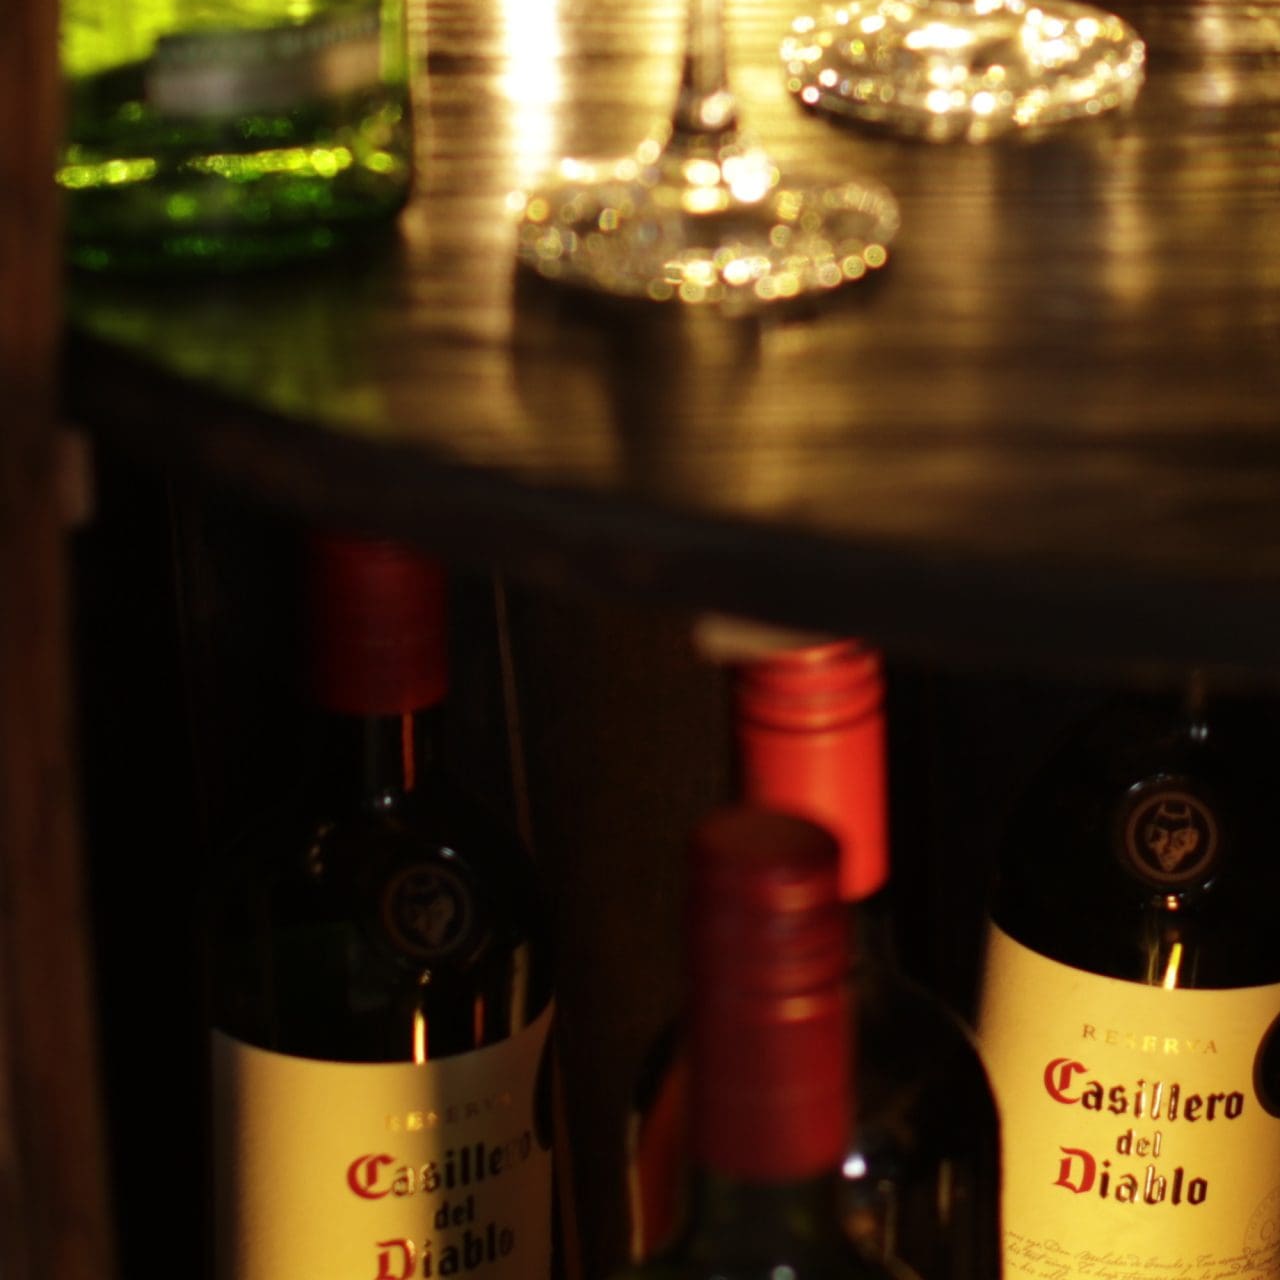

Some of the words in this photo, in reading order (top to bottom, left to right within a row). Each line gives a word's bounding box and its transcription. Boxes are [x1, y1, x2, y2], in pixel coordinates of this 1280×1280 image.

[1082, 1023, 1218, 1055] RESERVA
[1043, 1056, 1245, 1123] Casillero
[346, 1130, 532, 1201] Casillero
[1115, 1128, 1162, 1159] del
[1052, 1145, 1209, 1206] Diablo
[433, 1194, 476, 1231] del
[374, 1221, 515, 1280] Diablo
